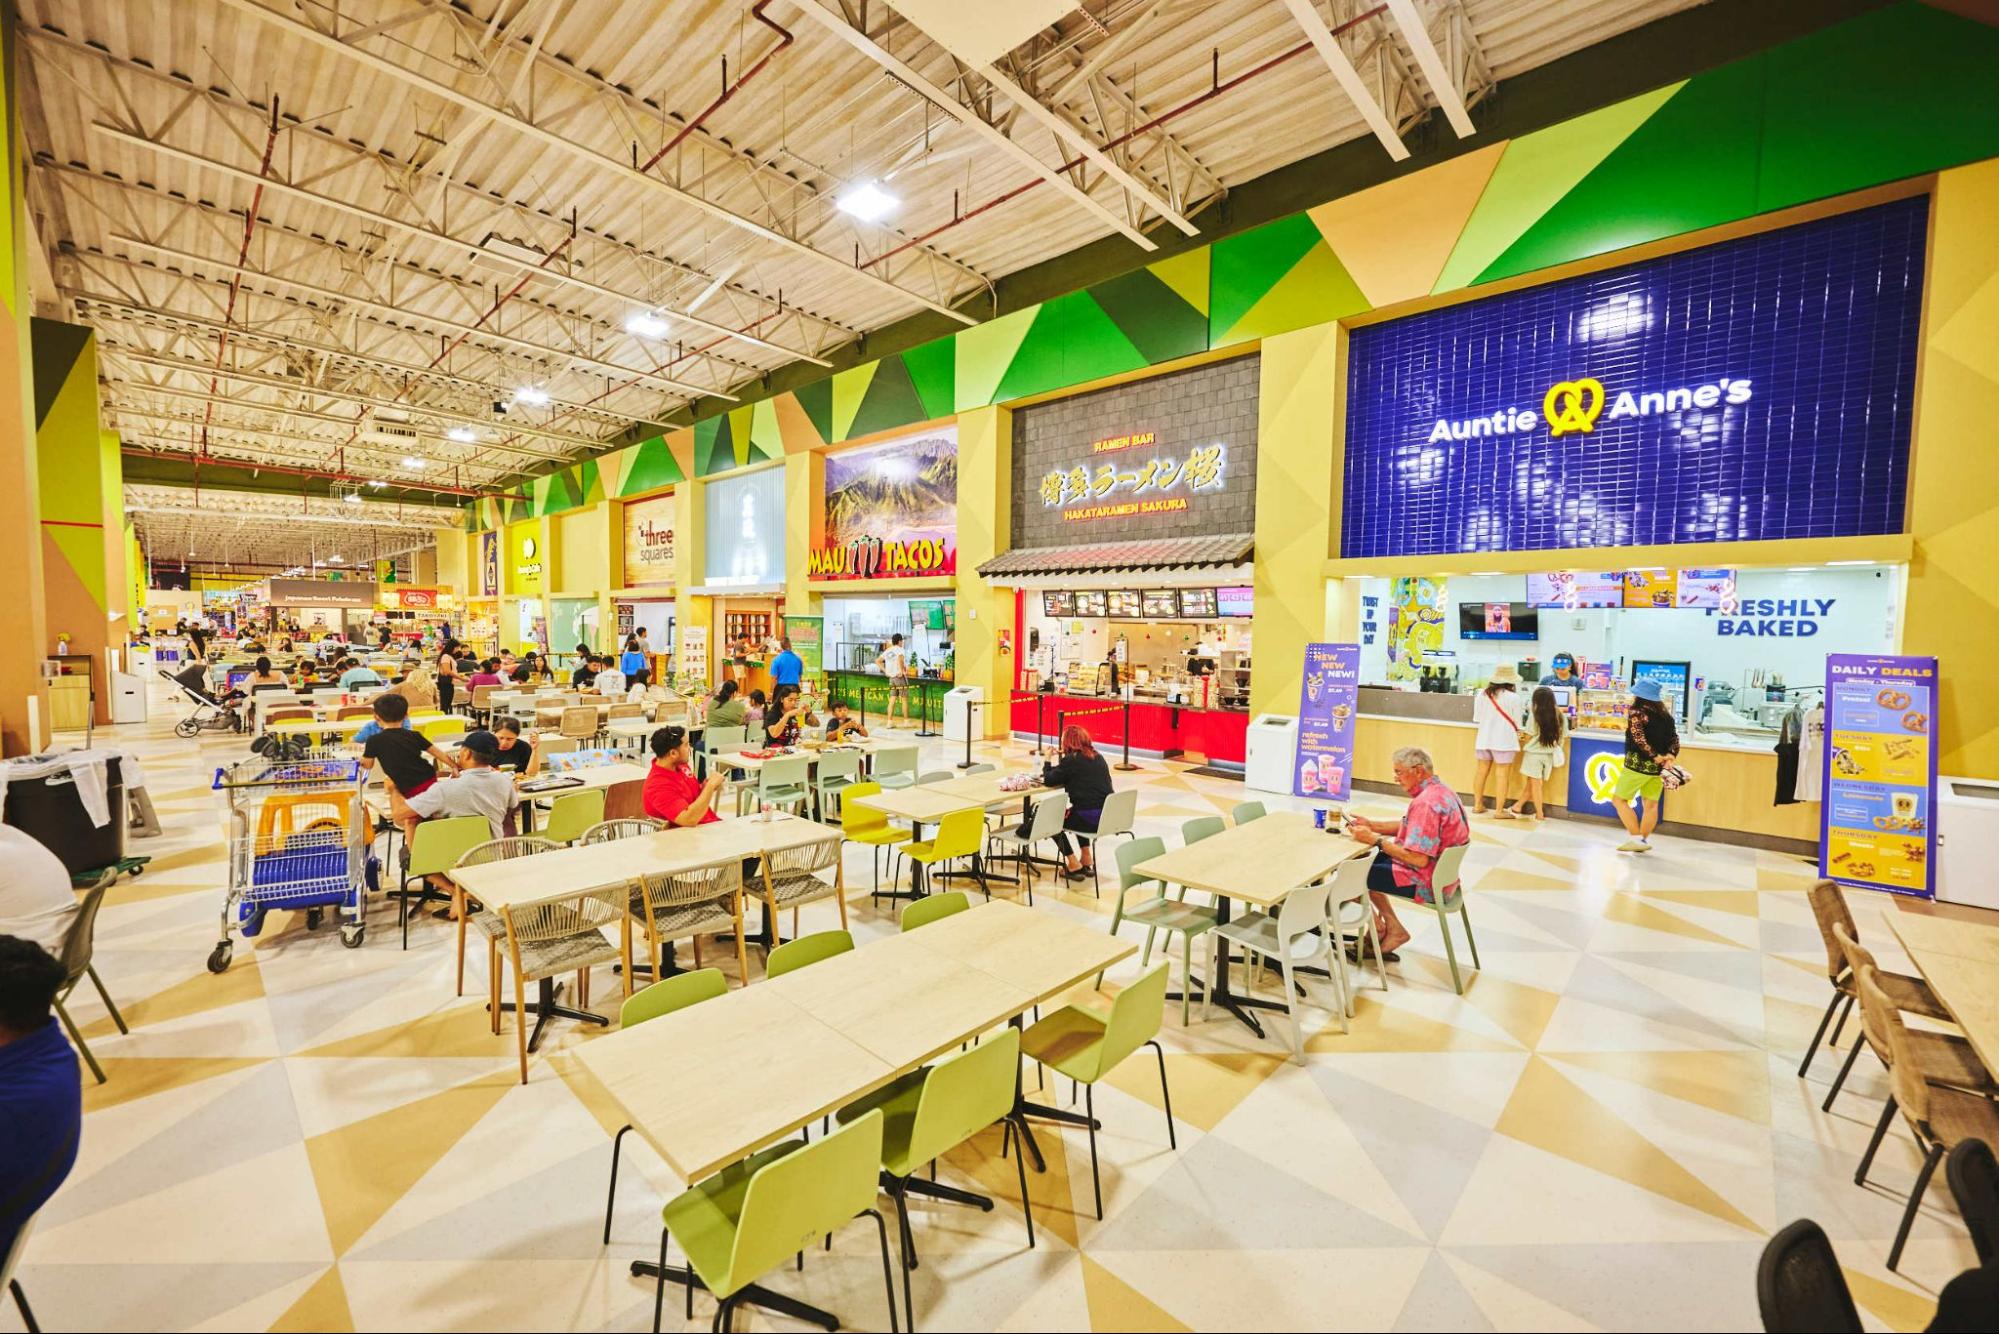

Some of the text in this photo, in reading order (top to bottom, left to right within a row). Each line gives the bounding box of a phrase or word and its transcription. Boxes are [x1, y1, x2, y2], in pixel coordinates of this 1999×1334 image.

[1428, 377, 1753, 443] Auntie Anne's
[1094, 432, 1156, 453] RAMEN BAR
[1064, 497, 1188, 521] HAKATARAMEN SAKURA
[645, 520, 674, 547] three
[640, 547, 674, 565] squares
[884, 538, 945, 571] TACOS
[1717, 619, 1819, 637] BAKED
[1313, 653, 1338, 662] NEW
[1321, 662, 1346, 670] NEW
[1327, 670, 1355, 678] NEW!
[1831, 665, 1933, 678] DAILY DEALS
[848, 689, 884, 701] MEICAN
[1302, 732, 1329, 740] refresh
